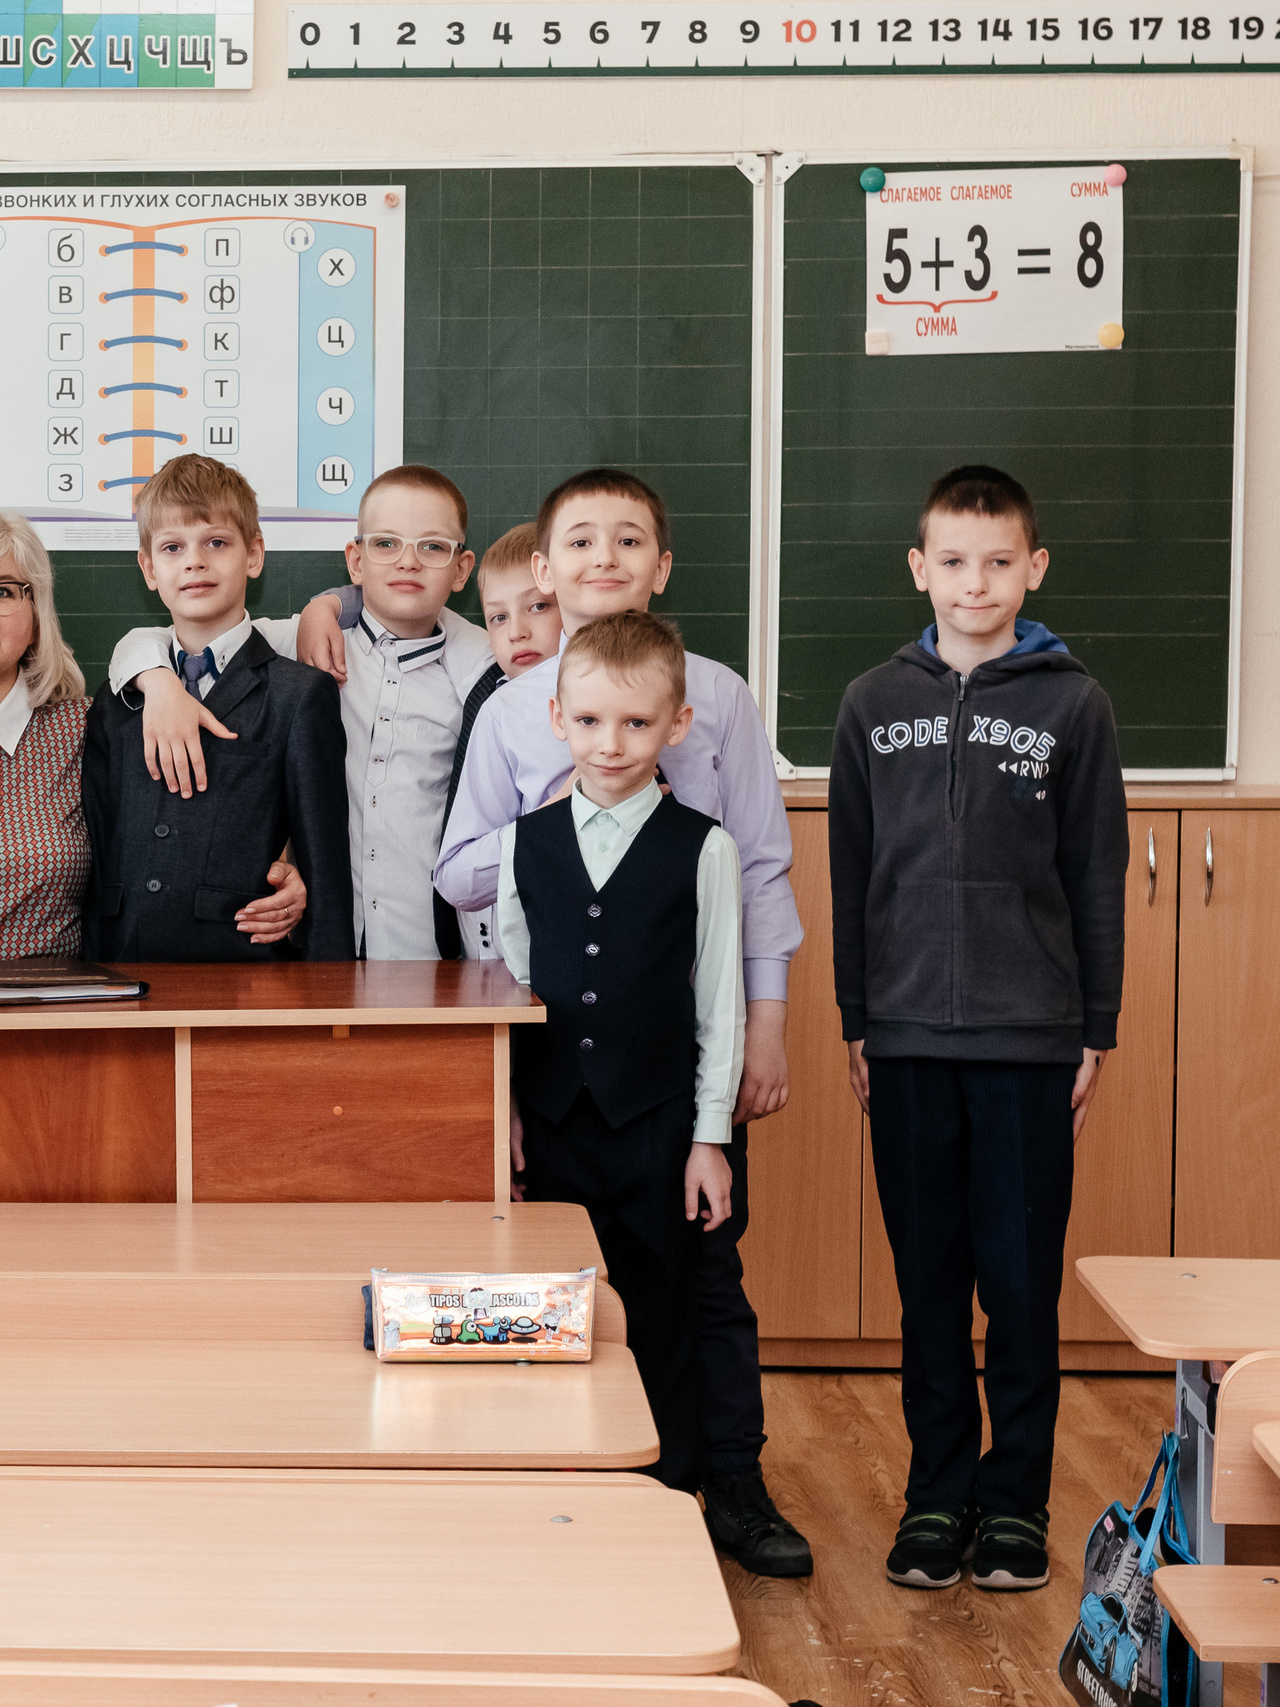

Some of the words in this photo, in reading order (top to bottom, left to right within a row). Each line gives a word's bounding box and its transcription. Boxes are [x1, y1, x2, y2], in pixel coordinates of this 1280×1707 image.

[300, 22, 321, 46] 0
[349, 22, 360, 45] 1
[396, 21, 416, 45] 2
[446, 21, 465, 46] 3
[492, 21, 513, 45] 4
[543, 21, 562, 45] 5
[589, 20, 610, 45] 6
[641, 21, 661, 44] 7
[688, 20, 708, 44] 8
[739, 19, 760, 44] 9
[781, 18, 818, 44] 10
[830, 19, 860, 43] 11
[877, 18, 912, 42] 12
[928, 18, 962, 42] 13
[977, 18, 1013, 41] 14
[1026, 18, 1060, 42] 15
[1078, 17, 1114, 41] 16
[1129, 17, 1164, 41] 17
[1177, 16, 1211, 41] 18
[1229, 16, 1264, 40] 19
[83, 194, 95, 208] И
[100, 194, 169, 208] ГЛУХИХ
[175, 193, 288, 208] СОГЛАСНЫХ
[294, 192, 367, 207] ЗВУКОВ
[879, 185, 943, 204] СЛАГАЕМОЕ
[949, 183, 1013, 201] СЛАГАЕМОЕ
[1069, 181, 1109, 199] СУММА
[57, 233, 75, 263] б
[215, 238, 229, 257] п
[208, 278, 236, 311] ф
[326, 325, 345, 349] ц
[915, 315, 959, 338] СУММА
[59, 333, 72, 351] г
[871, 716, 948, 754] CODE
[429, 1293, 461, 1308] TIPOS
[490, 1292, 540, 1308] ASCOTAS
